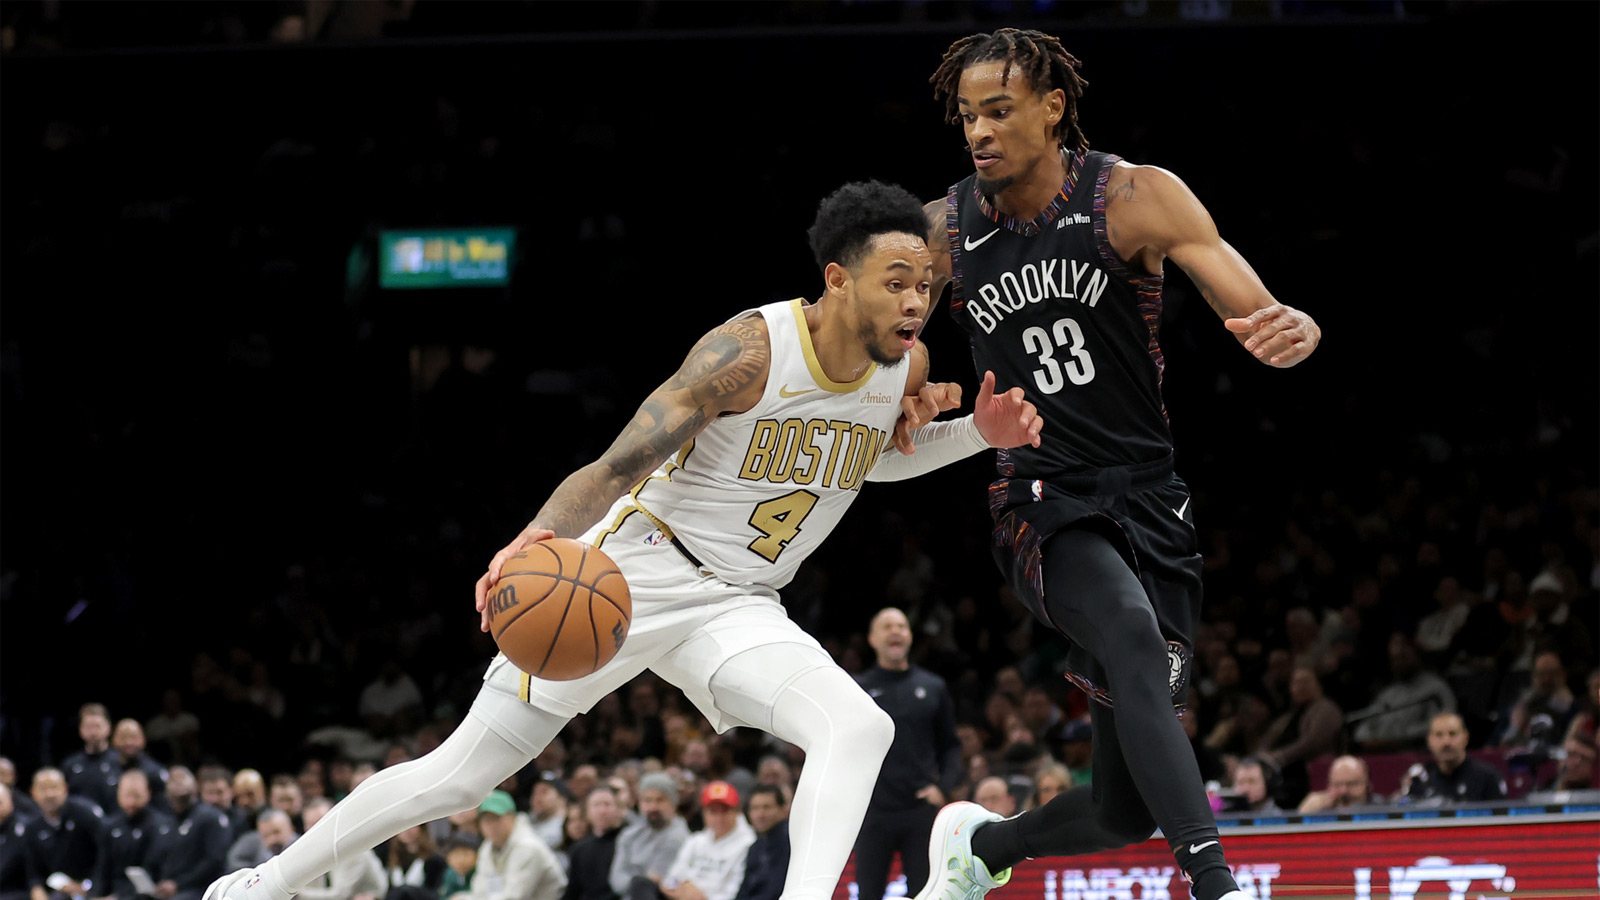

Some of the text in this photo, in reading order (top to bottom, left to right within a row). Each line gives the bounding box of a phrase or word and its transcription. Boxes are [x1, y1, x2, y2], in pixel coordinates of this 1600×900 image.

[1056, 212, 1091, 231] All In Won
[966, 258, 1108, 335] BROOKLYN
[712, 348, 767, 397] VILLAGE
[1022, 317, 1096, 395] 33
[860, 391, 893, 404] Amica
[738, 418, 886, 491] BOSTON
[747, 488, 820, 564] 4
